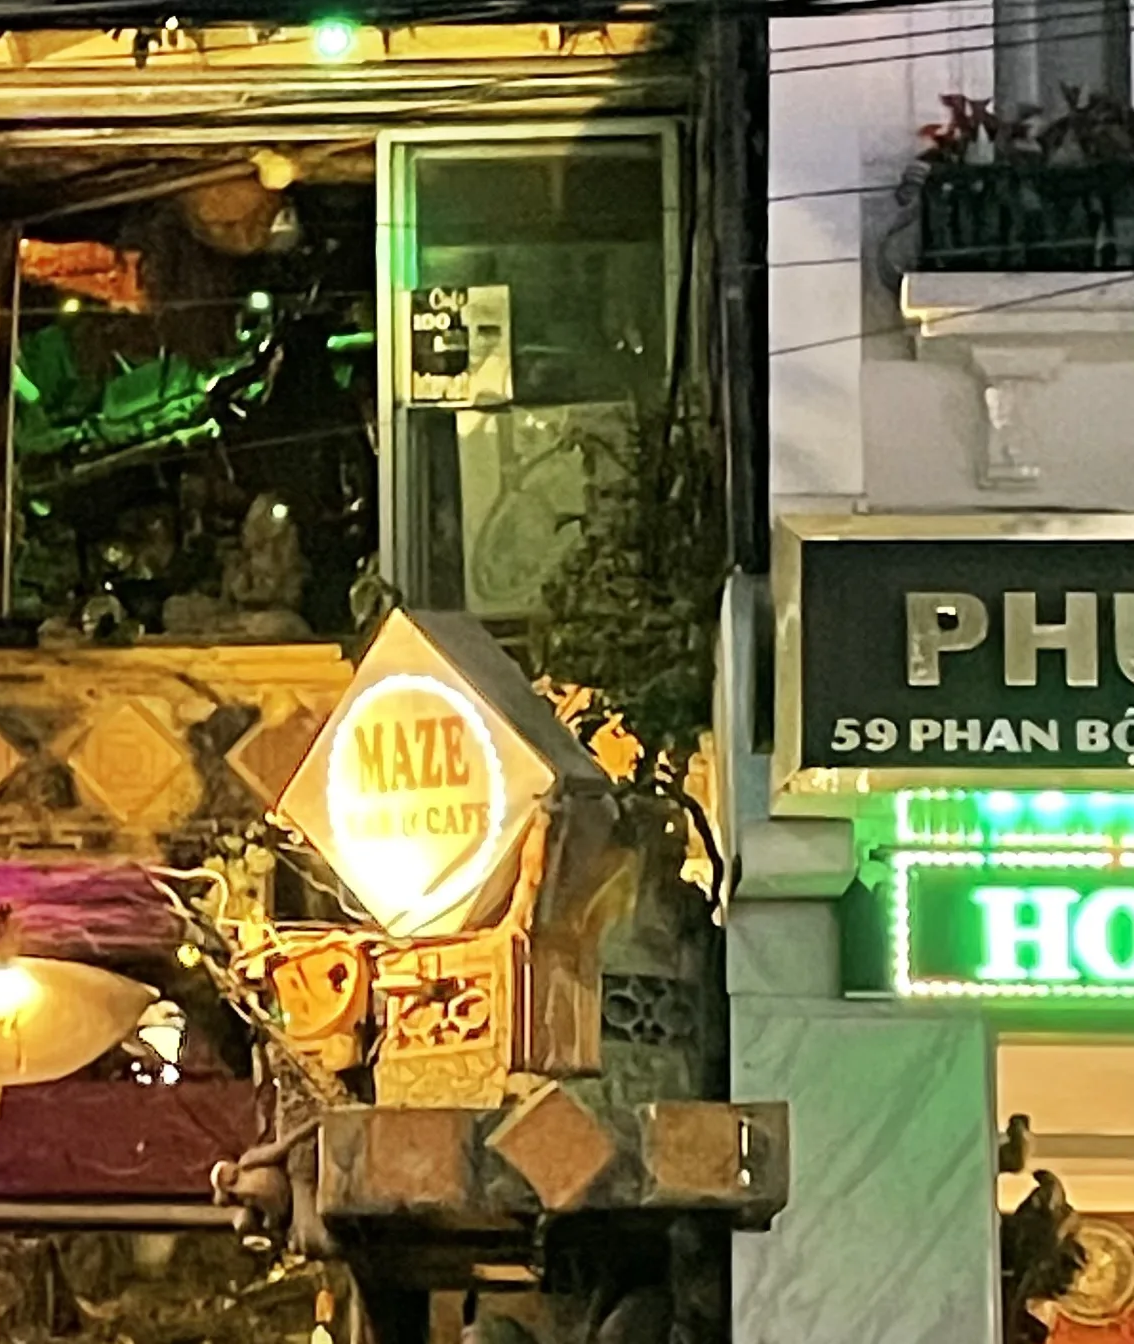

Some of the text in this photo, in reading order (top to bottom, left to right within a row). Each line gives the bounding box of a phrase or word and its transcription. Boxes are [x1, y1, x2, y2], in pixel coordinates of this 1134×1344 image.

[354, 716, 470, 793] MAZE
[831, 718, 898, 752] 59
[910, 719, 1059, 752] PHAN
